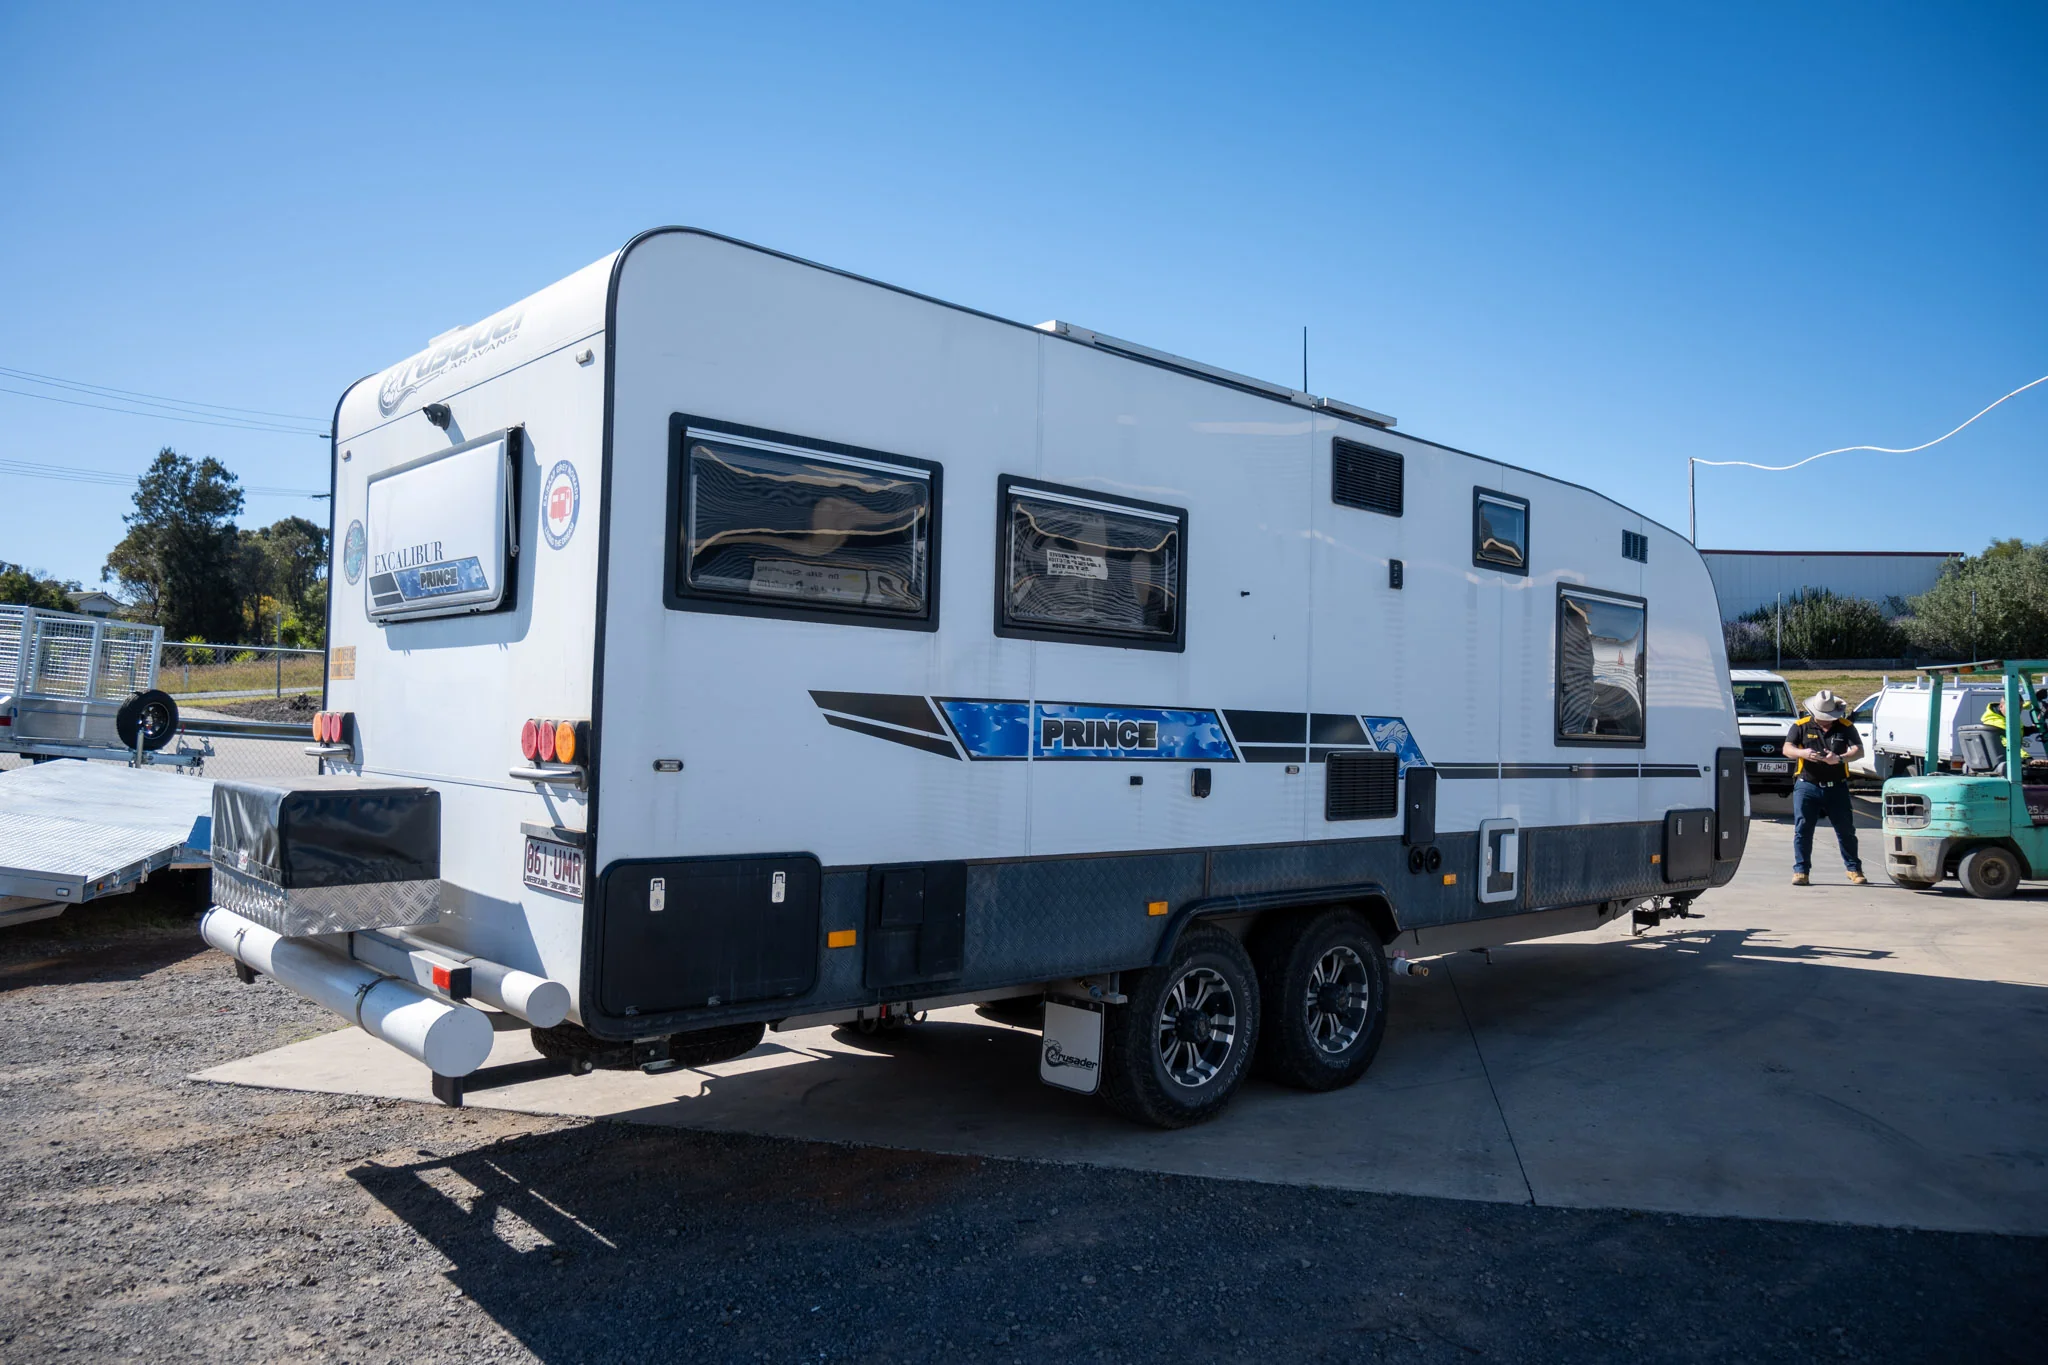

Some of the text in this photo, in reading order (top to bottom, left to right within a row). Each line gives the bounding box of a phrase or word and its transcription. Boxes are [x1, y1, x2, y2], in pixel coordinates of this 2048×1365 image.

[441, 334, 519, 375] CARAVANS
[374, 541, 443, 574] EXCALIBUR
[420, 567, 458, 590] PRINCE
[1042, 718, 1158, 751] PRINCE
[2027, 805, 2039, 814] 25
[1045, 1045, 1098, 1069] Crusader
